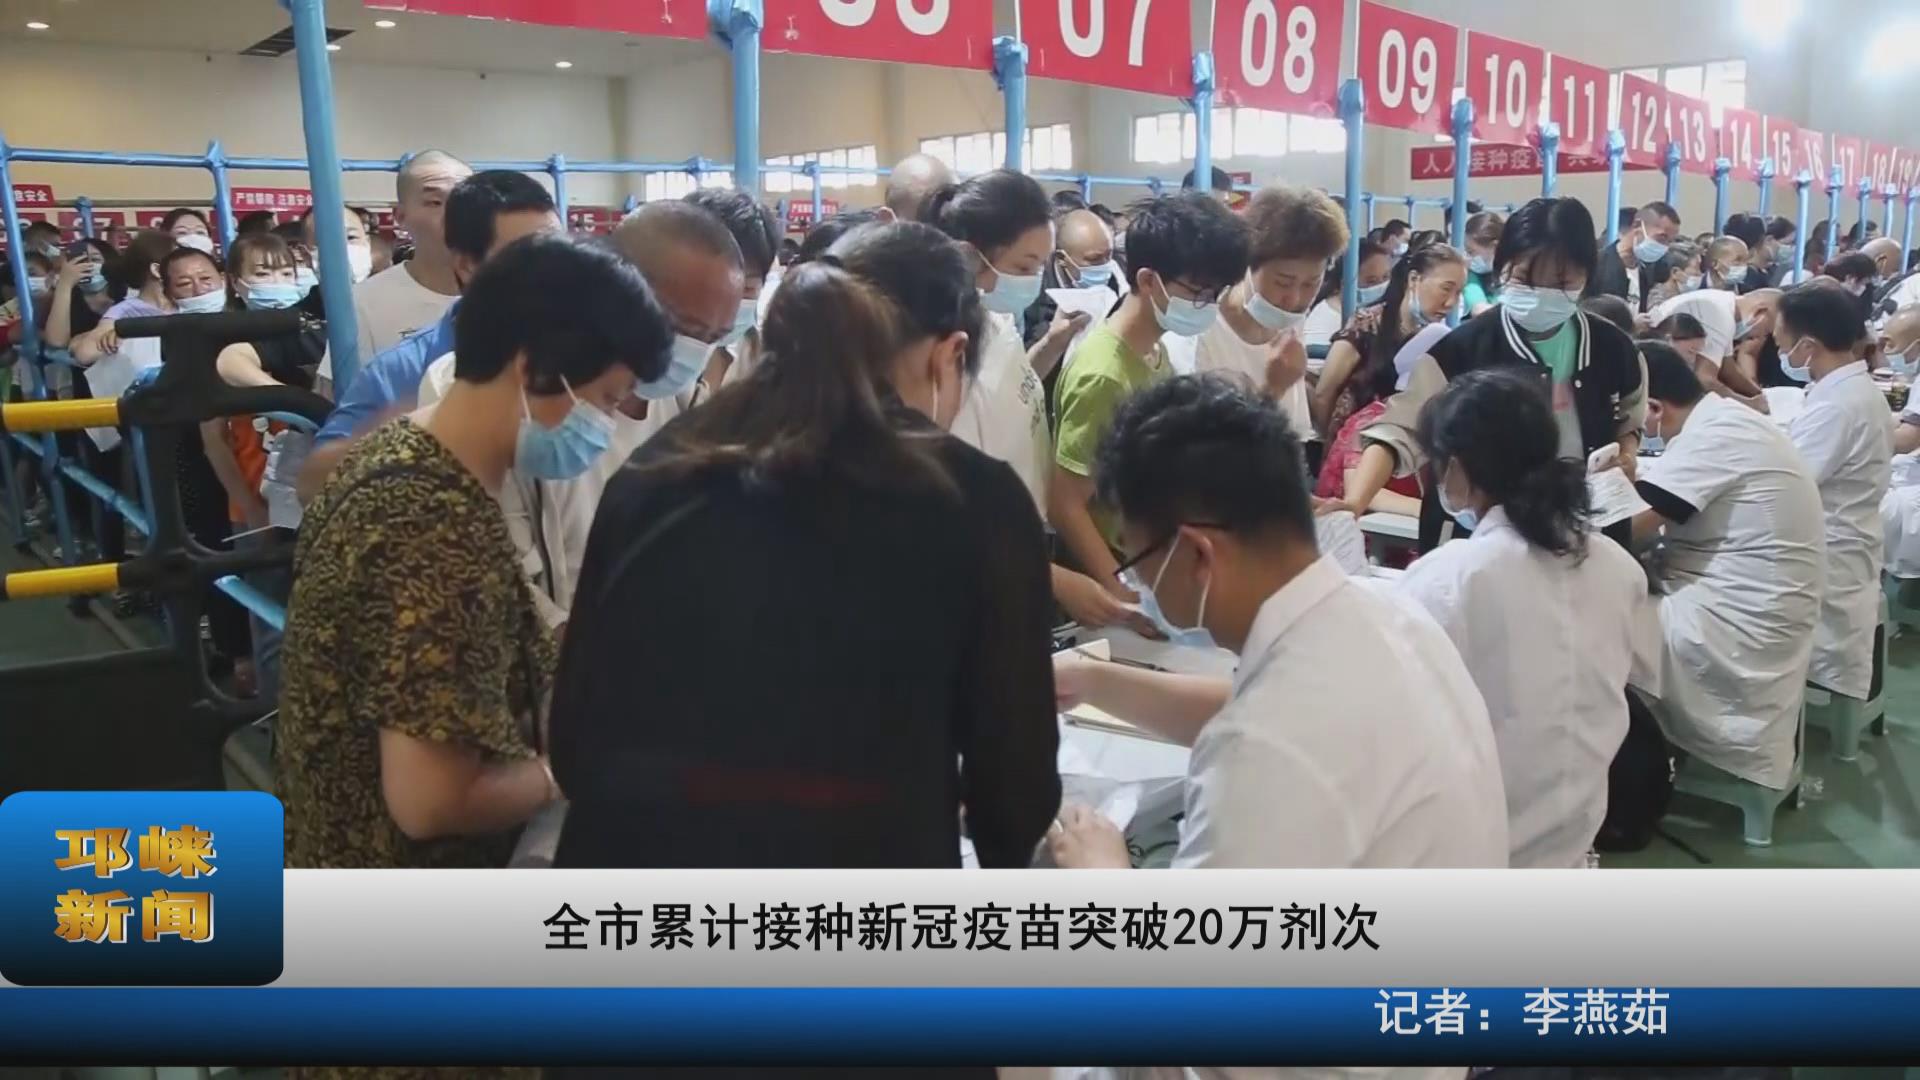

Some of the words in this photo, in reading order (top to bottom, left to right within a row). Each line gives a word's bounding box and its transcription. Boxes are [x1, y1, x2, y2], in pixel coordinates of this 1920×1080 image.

[1241, 0, 1317, 94] 08
[1379, 29, 1437, 114] 09
[1485, 54, 1527, 128] 10
[1563, 75, 1595, 142] 11
[1631, 92, 1658, 154] 12
[1679, 107, 1706, 162] 13
[1730, 119, 1753, 170] 14
[1772, 130, 1791, 176] 15
[1804, 139, 1825, 181] 16
[1840, 146, 1855, 187] 17
[1872, 152, 1888, 194] 18
[570, 213, 596, 232] 15
